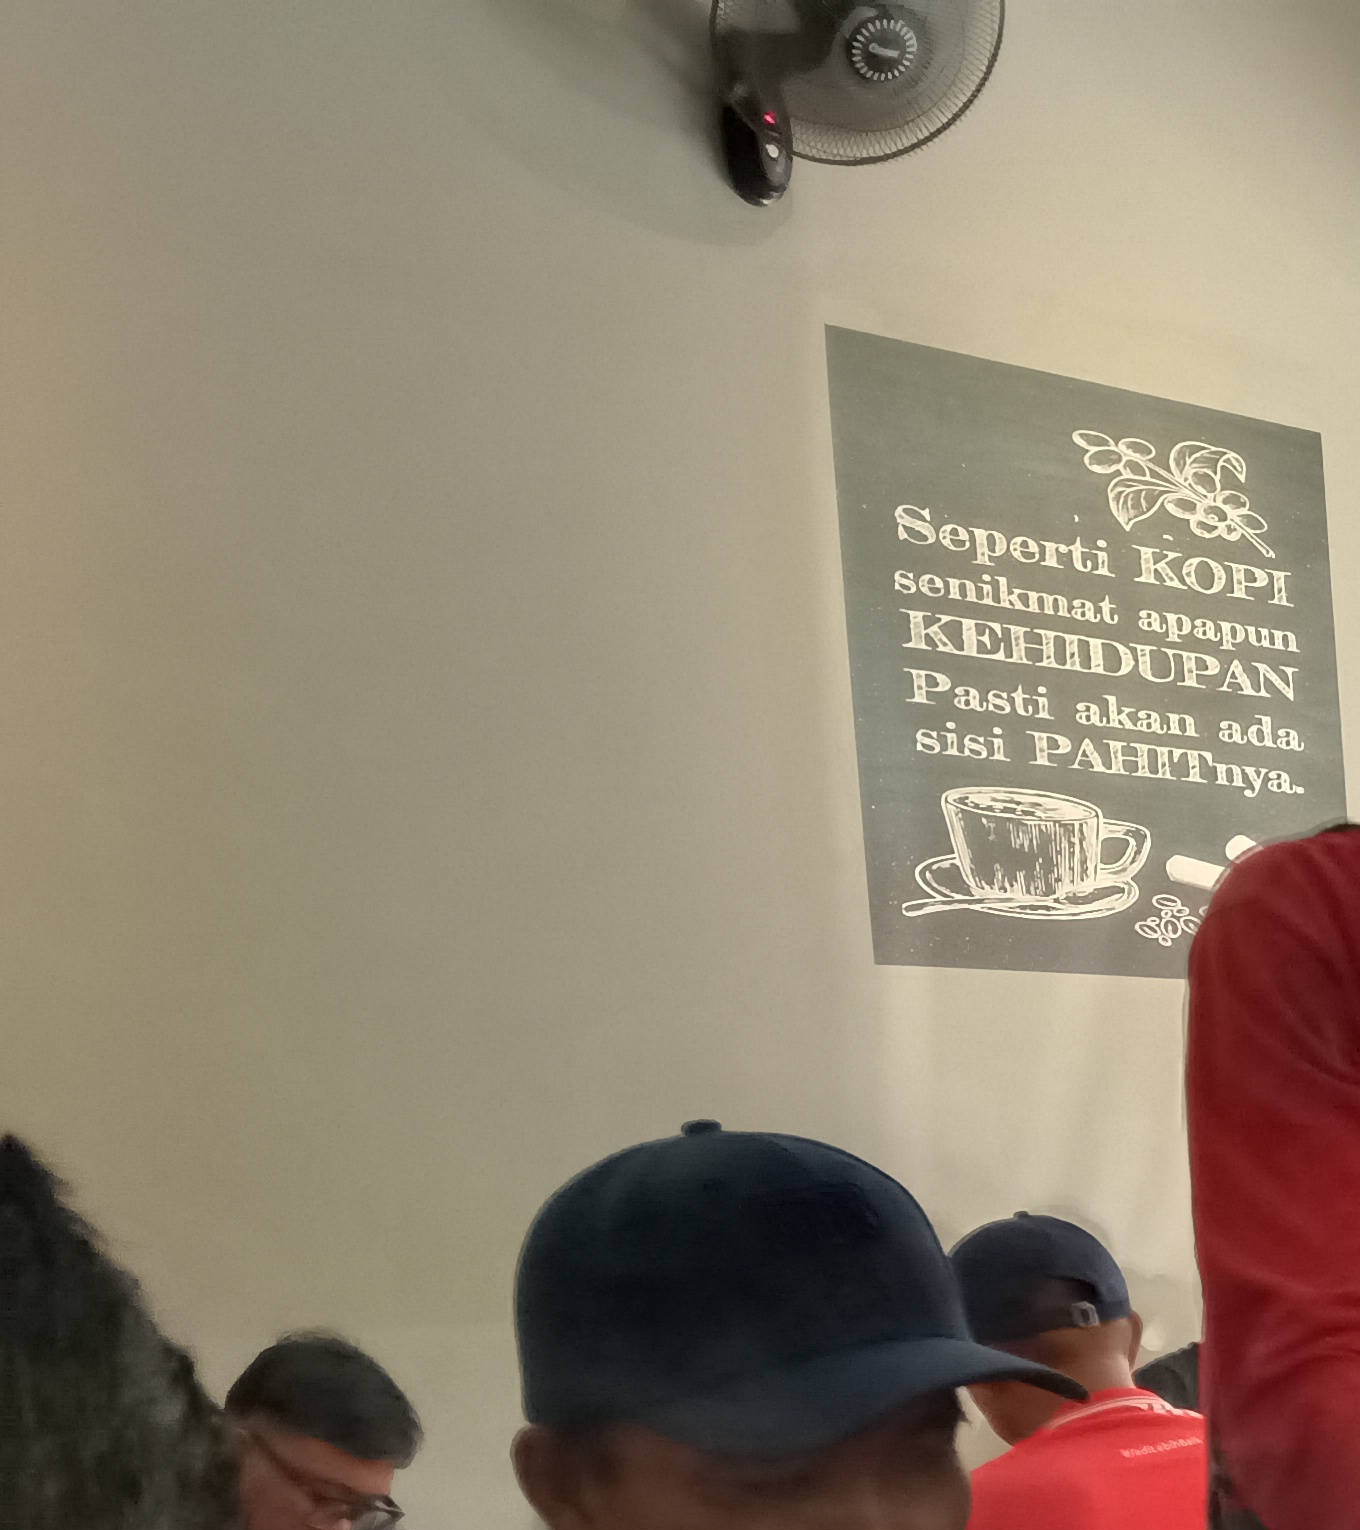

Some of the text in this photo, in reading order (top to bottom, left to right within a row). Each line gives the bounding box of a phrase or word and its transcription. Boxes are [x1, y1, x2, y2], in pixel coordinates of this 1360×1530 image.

[893, 504, 1295, 608] Seperti KOPI
[893, 569, 1301, 653] senikmat apapun
[899, 608, 1300, 702] KEHIDUPAN
[902, 667, 1305, 753] Pasti akan ada
[915, 720, 1306, 798] sisi PAHITnya.
